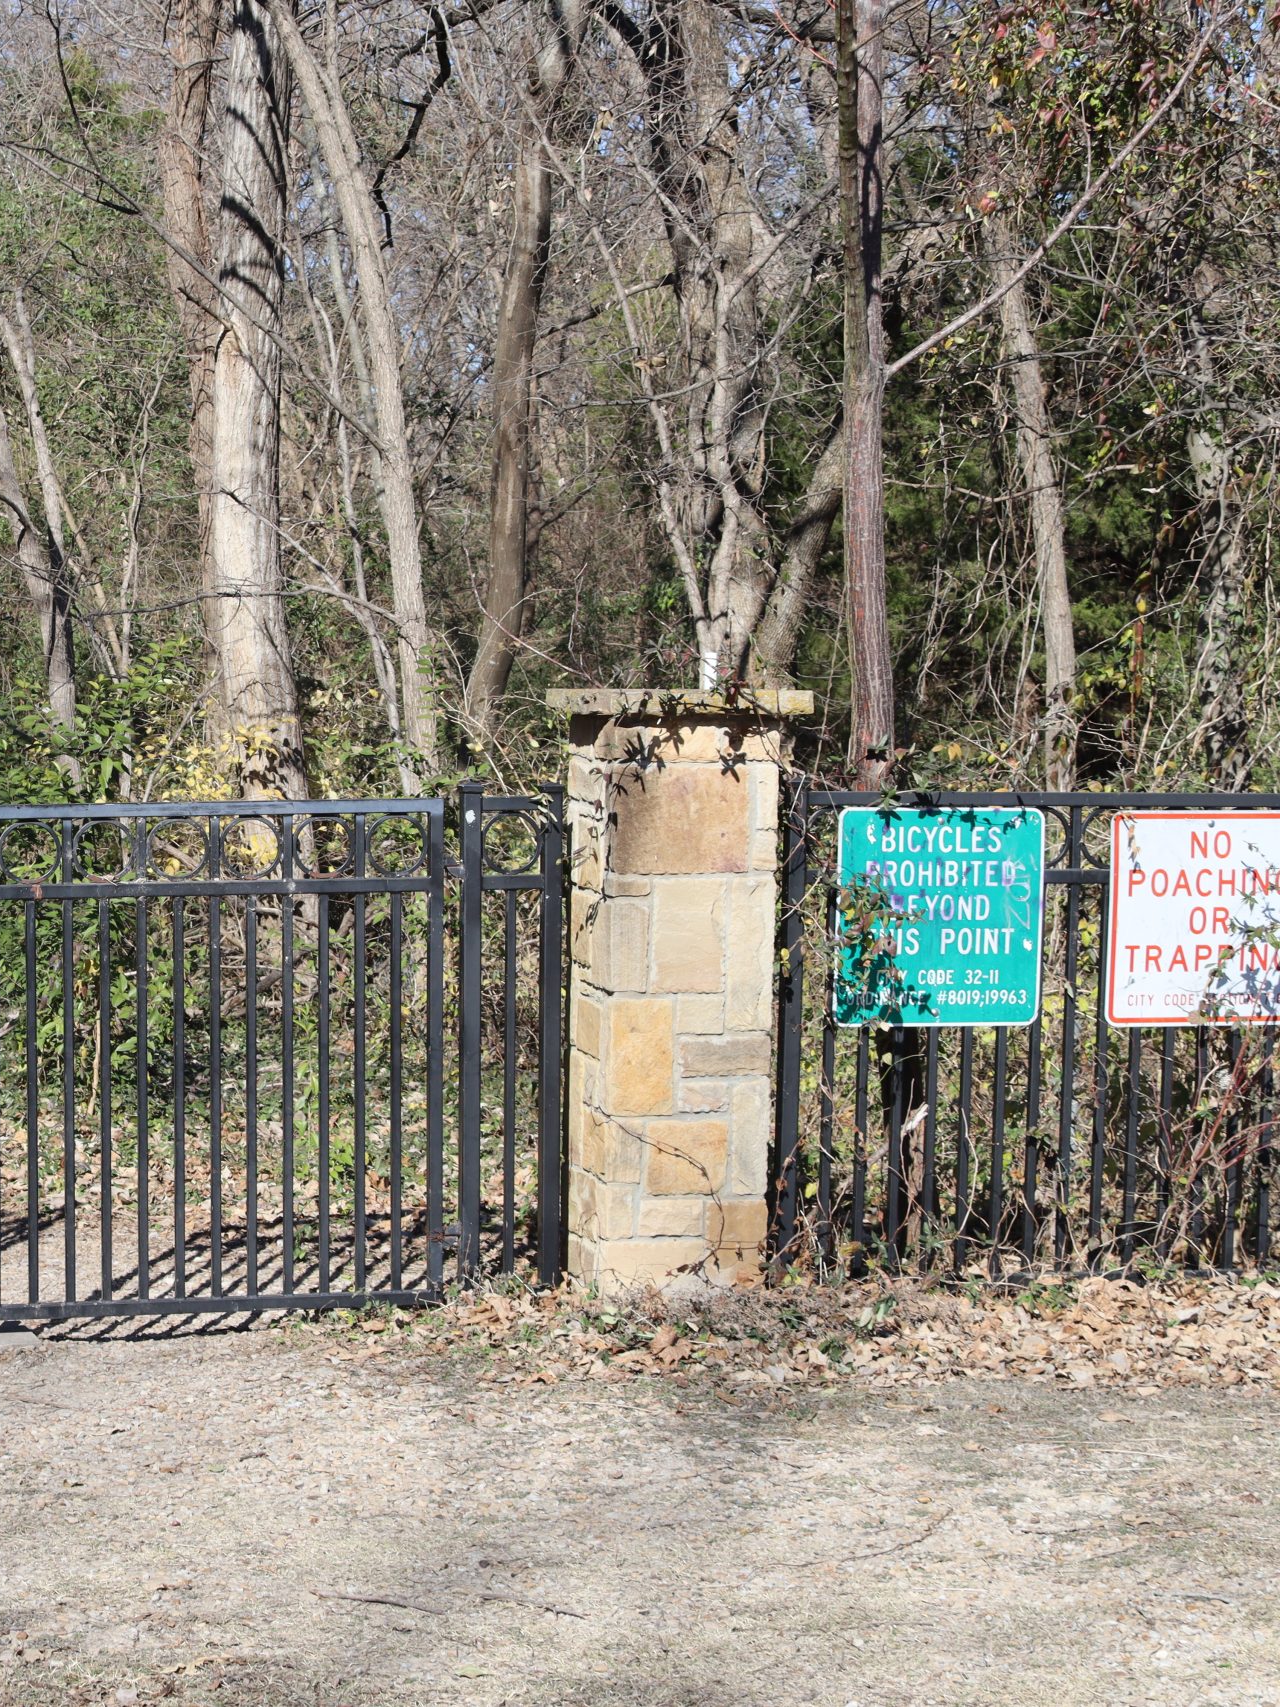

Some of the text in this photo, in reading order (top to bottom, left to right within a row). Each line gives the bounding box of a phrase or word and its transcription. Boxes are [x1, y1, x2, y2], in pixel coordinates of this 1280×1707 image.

[881, 825, 1002, 853] BICYCLES
[1190, 830, 1232, 859] NO
[866, 860, 1017, 888] PROHIBITED
[1189, 906, 1231, 935] OR
[940, 927, 1015, 956] POINT
[917, 969, 954, 985] CODE
[964, 969, 1000, 985] 32-11
[936, 989, 1027, 1008] #8019;19963
[1127, 993, 1154, 1007] CITY
[1163, 993, 1195, 1007] CODE
